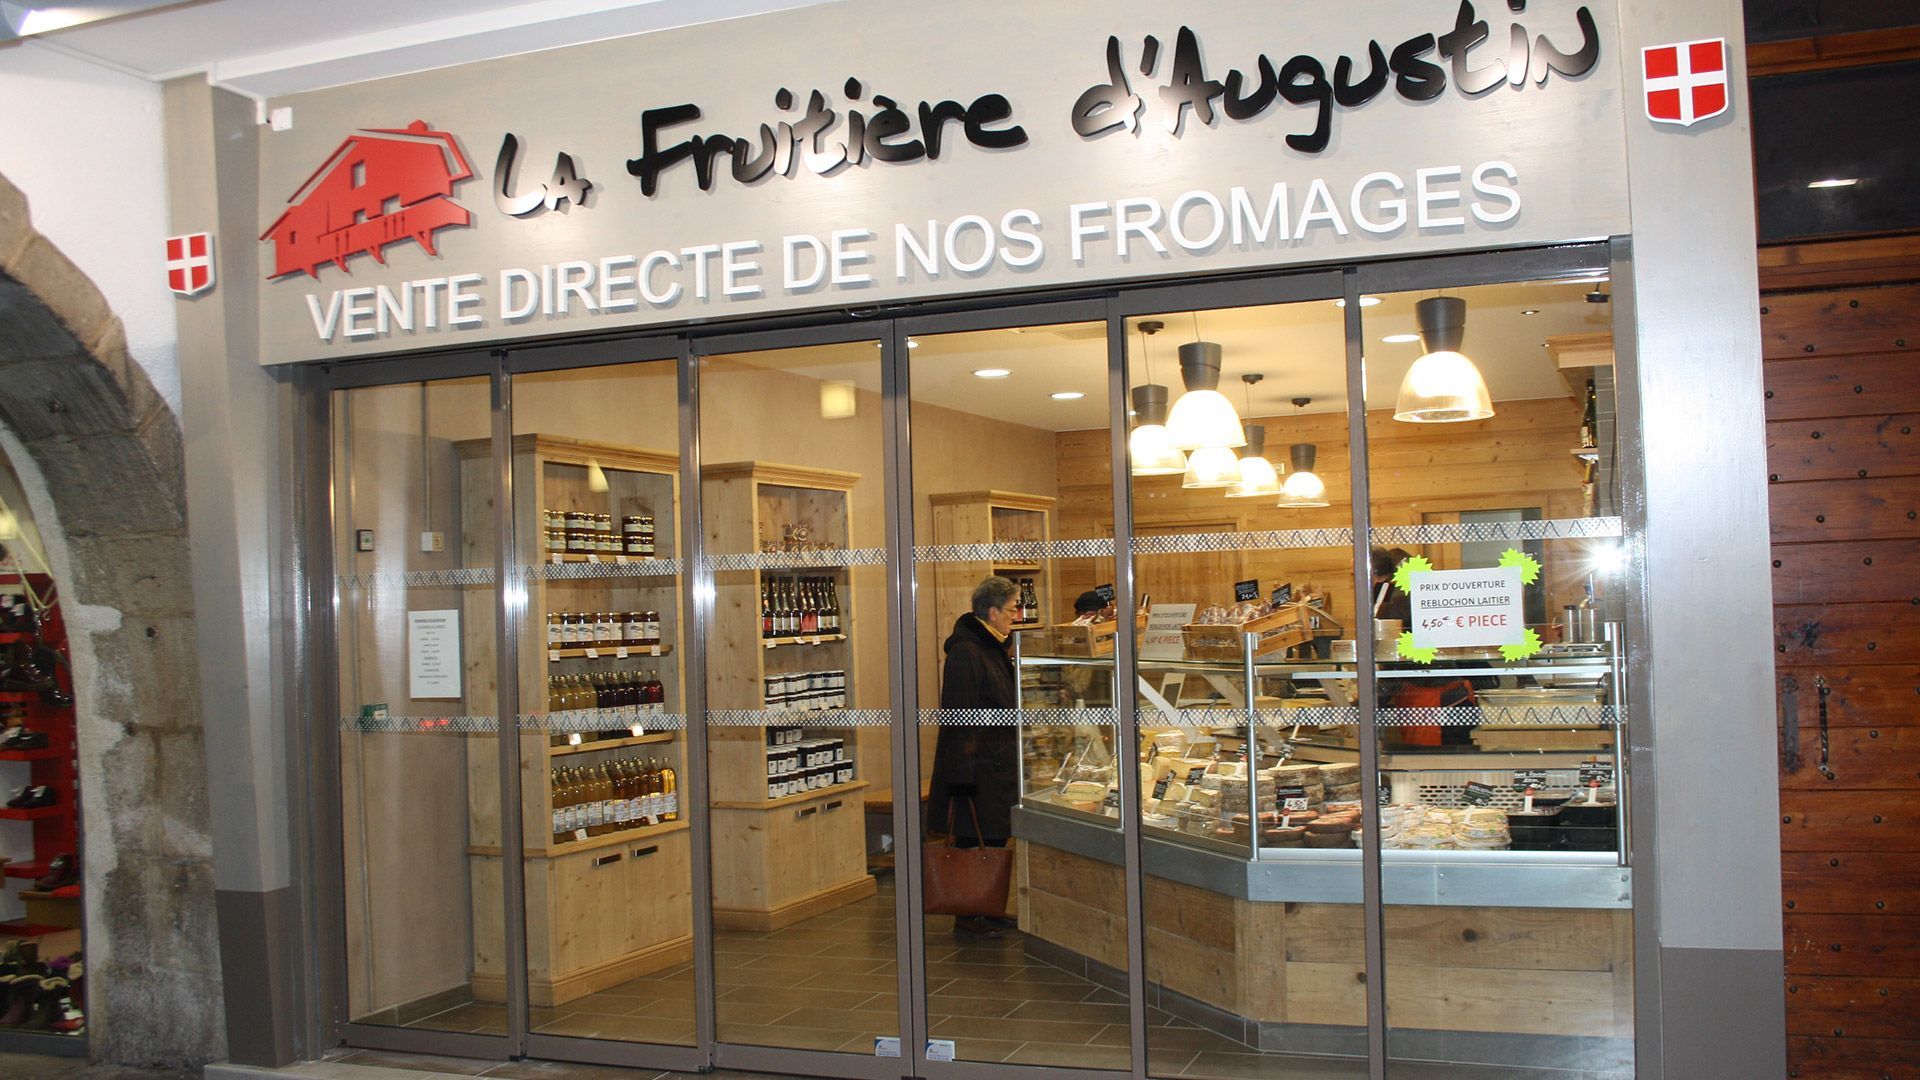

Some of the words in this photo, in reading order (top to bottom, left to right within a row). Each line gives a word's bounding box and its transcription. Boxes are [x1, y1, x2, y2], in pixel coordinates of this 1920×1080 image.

[626, 76, 1029, 197] Fruitière
[305, 273, 483, 340] VENTE
[500, 240, 762, 319] DIRECTE
[783, 228, 872, 289] DE
[895, 208, 1044, 278] NOS
[1070, 161, 1522, 261] FROMAGES
[1420, 583, 1440, 591] PRIX
[1442, 580, 1506, 590] D'OUVERTURE
[1421, 597, 1475, 607] REBLOCHON
[1477, 596, 1510, 605] LAITIER
[1456, 616, 1464, 627] €
[1469, 614, 1507, 627] PIECE
